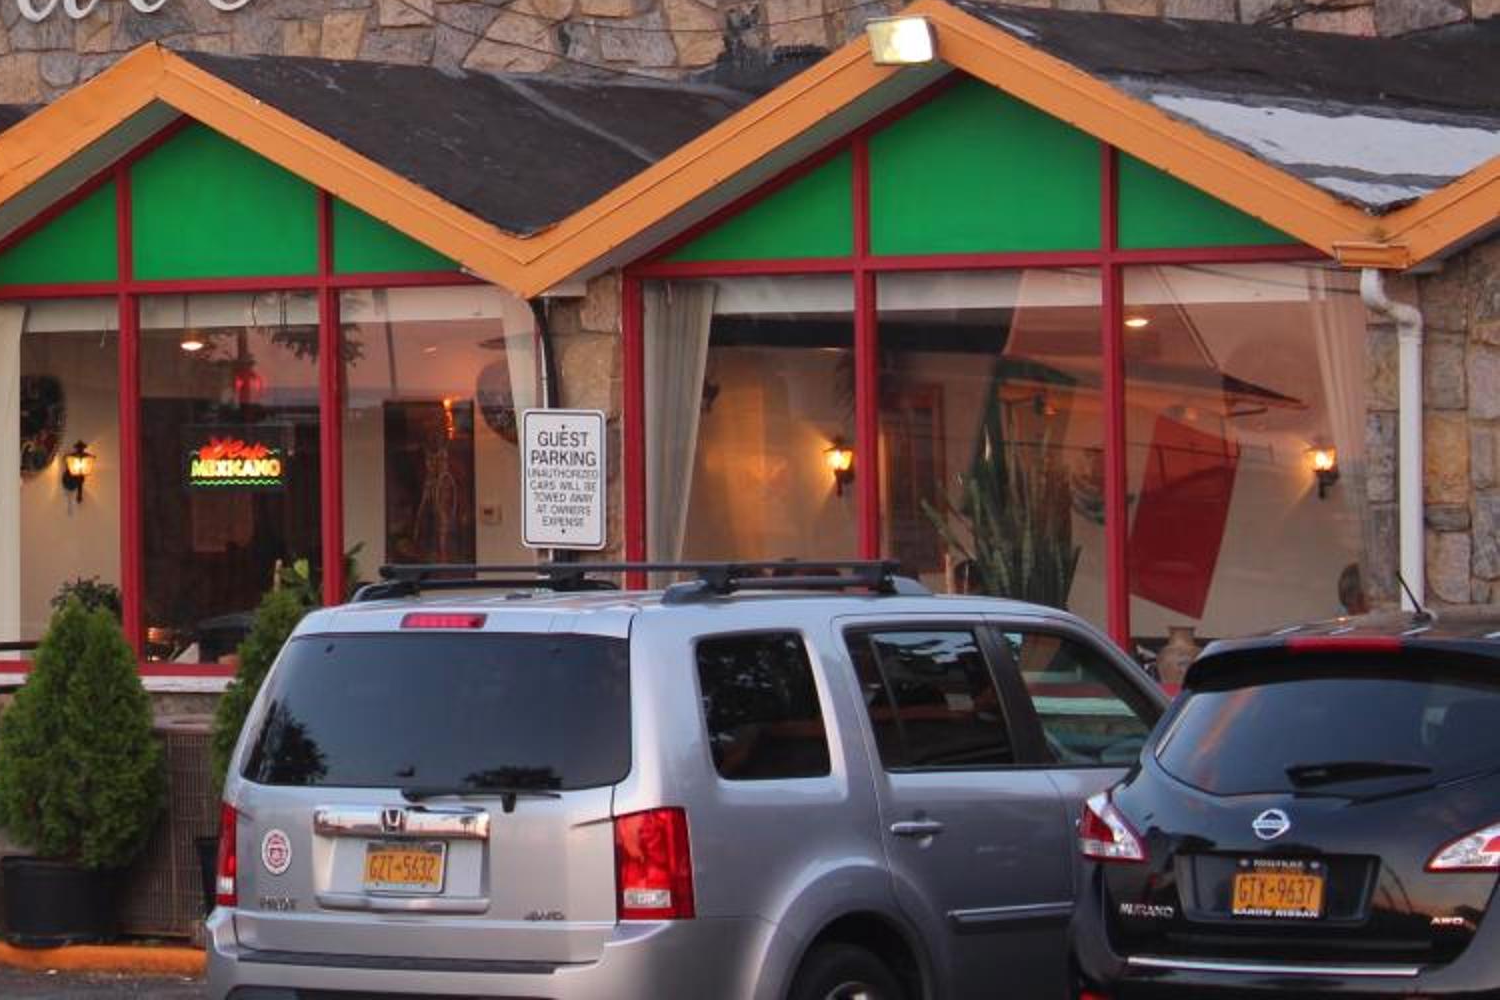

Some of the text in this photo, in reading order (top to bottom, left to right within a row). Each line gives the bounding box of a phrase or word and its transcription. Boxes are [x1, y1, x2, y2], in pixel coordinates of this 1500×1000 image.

[537, 431, 589, 447] GUEST
[530, 450, 597, 467] PARKING
[529, 480, 557, 490] CARS
[559, 481, 581, 491] WILL
[532, 492, 566, 503] TOWED
[541, 516, 584, 527] EXPENSE
